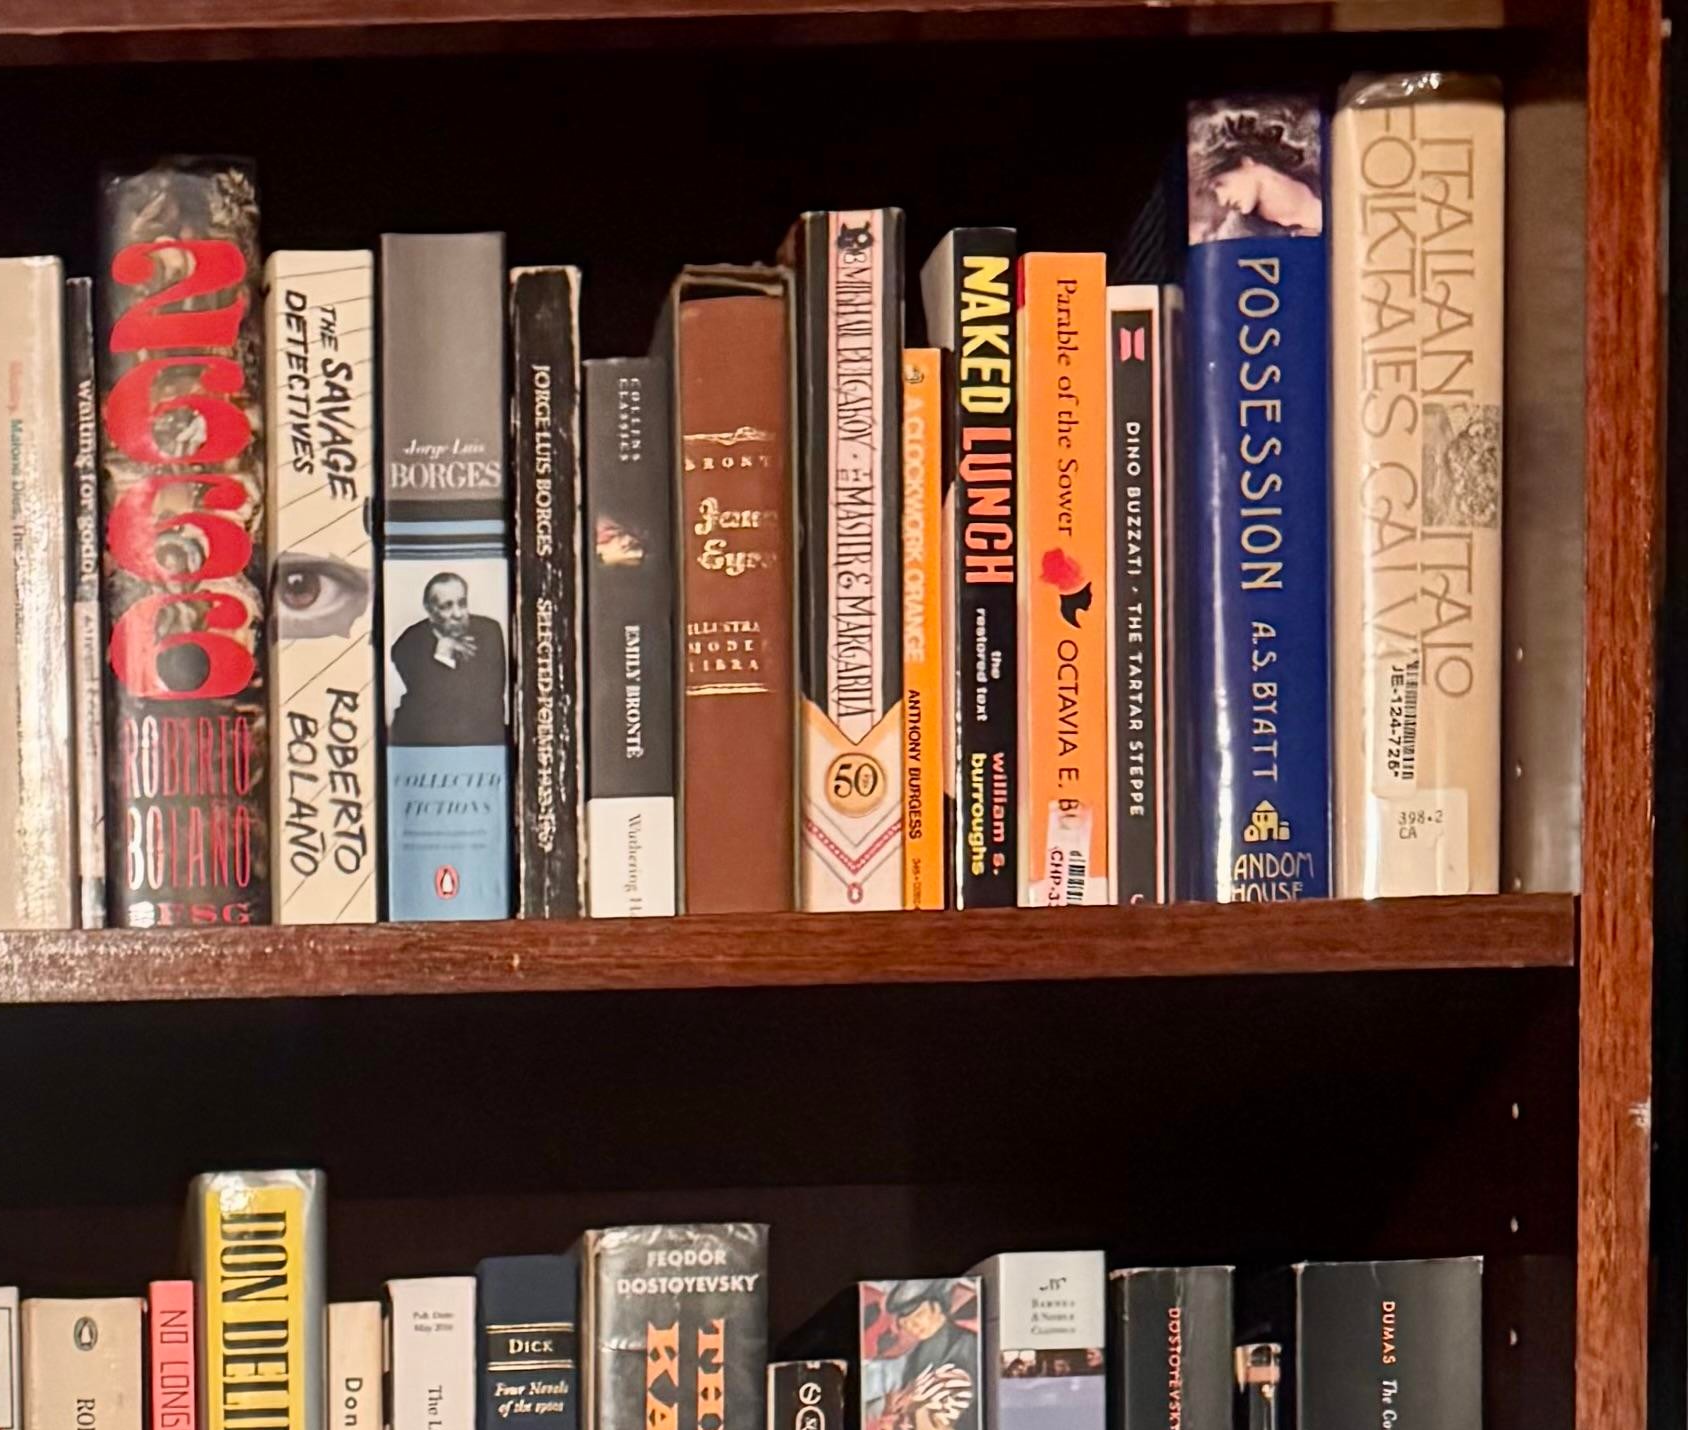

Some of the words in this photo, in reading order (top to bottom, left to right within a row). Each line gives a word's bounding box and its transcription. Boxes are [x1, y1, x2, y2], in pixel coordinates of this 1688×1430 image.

[321, 306, 340, 358] THE
[961, 256, 1011, 413] NAKED
[1058, 278, 1074, 365] Parable
[284, 289, 314, 477] DETECTIVES
[1060, 374, 1073, 398] of
[320, 362, 358, 501] SAVAGE
[1060, 407, 1076, 442] the
[1126, 422, 1141, 473] DINO
[1238, 258, 1283, 591] POSSESSION
[105, 237, 256, 700] 2666
[963, 427, 1014, 584] LUNCH
[1060, 458, 1074, 538] Sower
[1128, 485, 1142, 576] BUZZATI
[974, 608, 987, 680] restored
[1129, 603, 1142, 644] THE
[977, 687, 987, 721] text
[1129, 655, 1143, 729] TARTAR
[1252, 680, 1279, 782] BYATT
[286, 711, 320, 878] BOLAÑO
[326, 688, 361, 876] ROBERTO
[1131, 740, 1144, 818] STEPPE
[219, 1208, 287, 1321] DON
[617, 1275, 758, 1295] DOSTOYEVSKY
[509, 1338, 553, 1353] DICK
[1383, 1301, 1395, 1363] DUMAS
